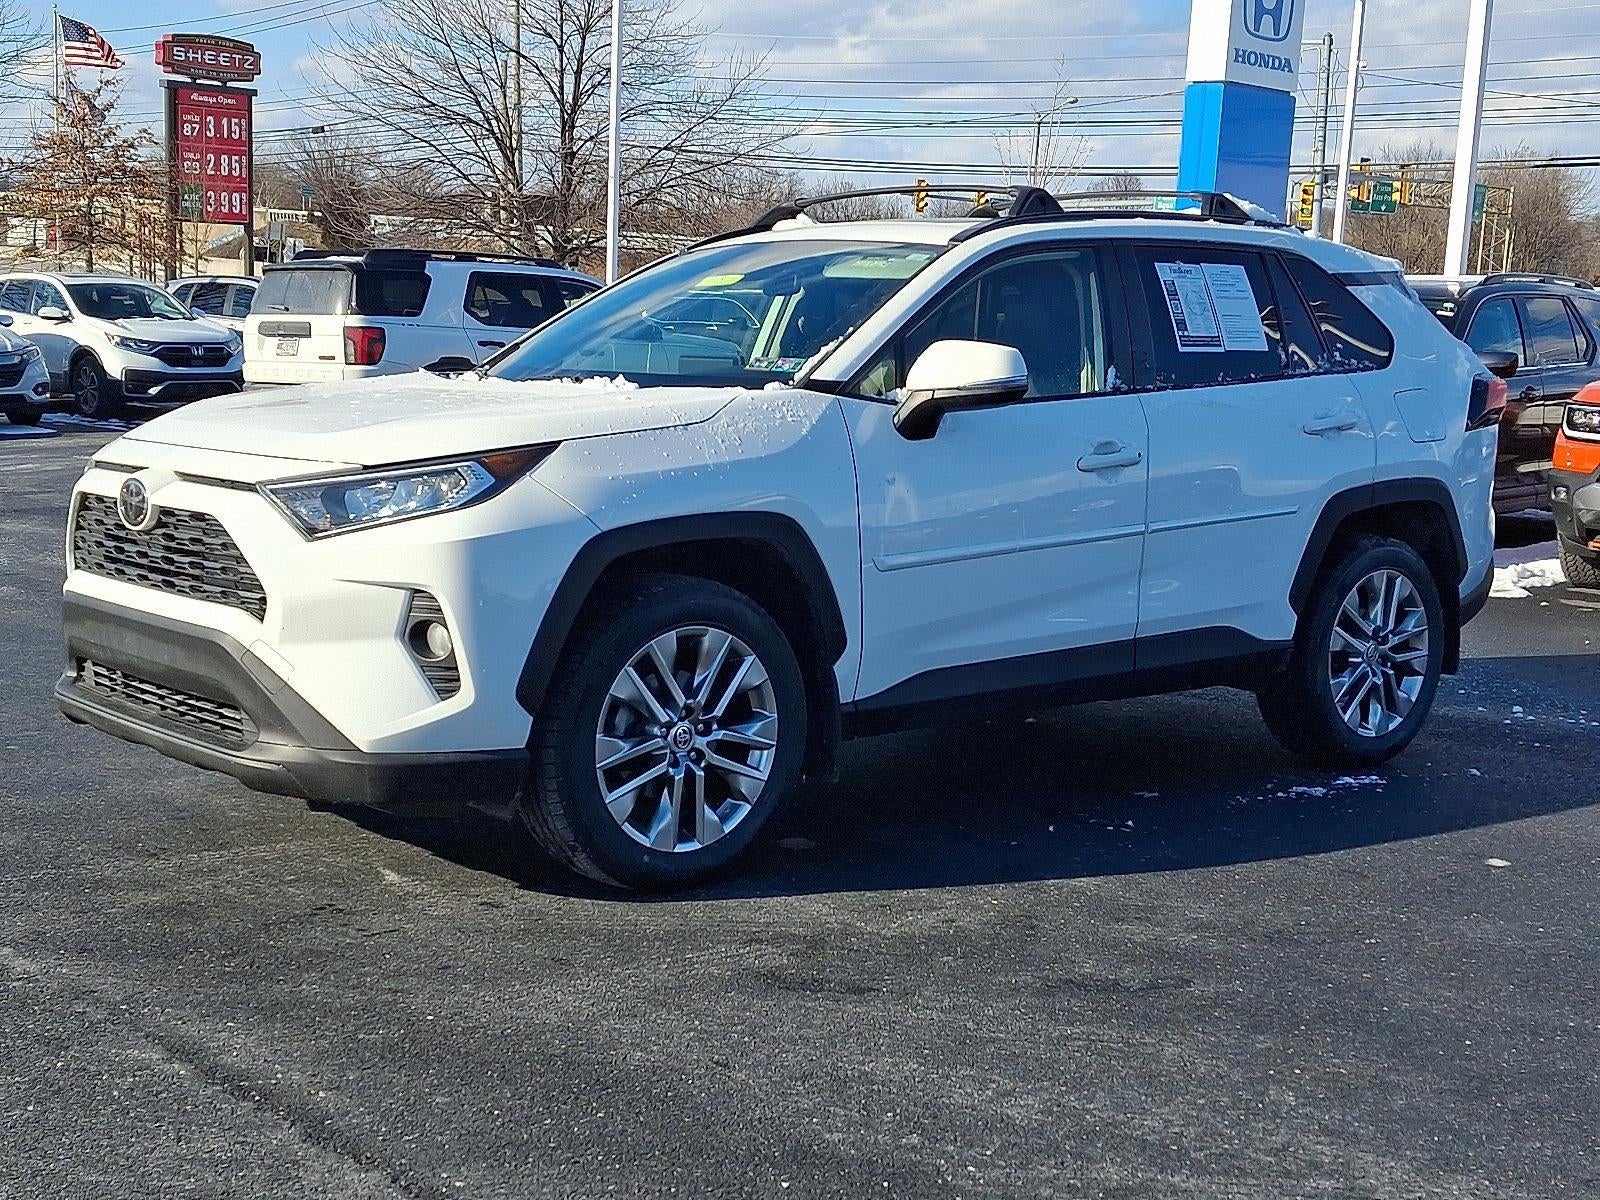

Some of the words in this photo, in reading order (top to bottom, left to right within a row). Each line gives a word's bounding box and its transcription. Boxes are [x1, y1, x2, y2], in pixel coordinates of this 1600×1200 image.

[172, 46, 255, 69] SHEETZ
[1233, 47, 1294, 73] HONDA
[190, 92, 217, 104] Always
[218, 95, 237, 105] Open
[182, 113, 200, 122] UNLD
[182, 122, 200, 136] 87
